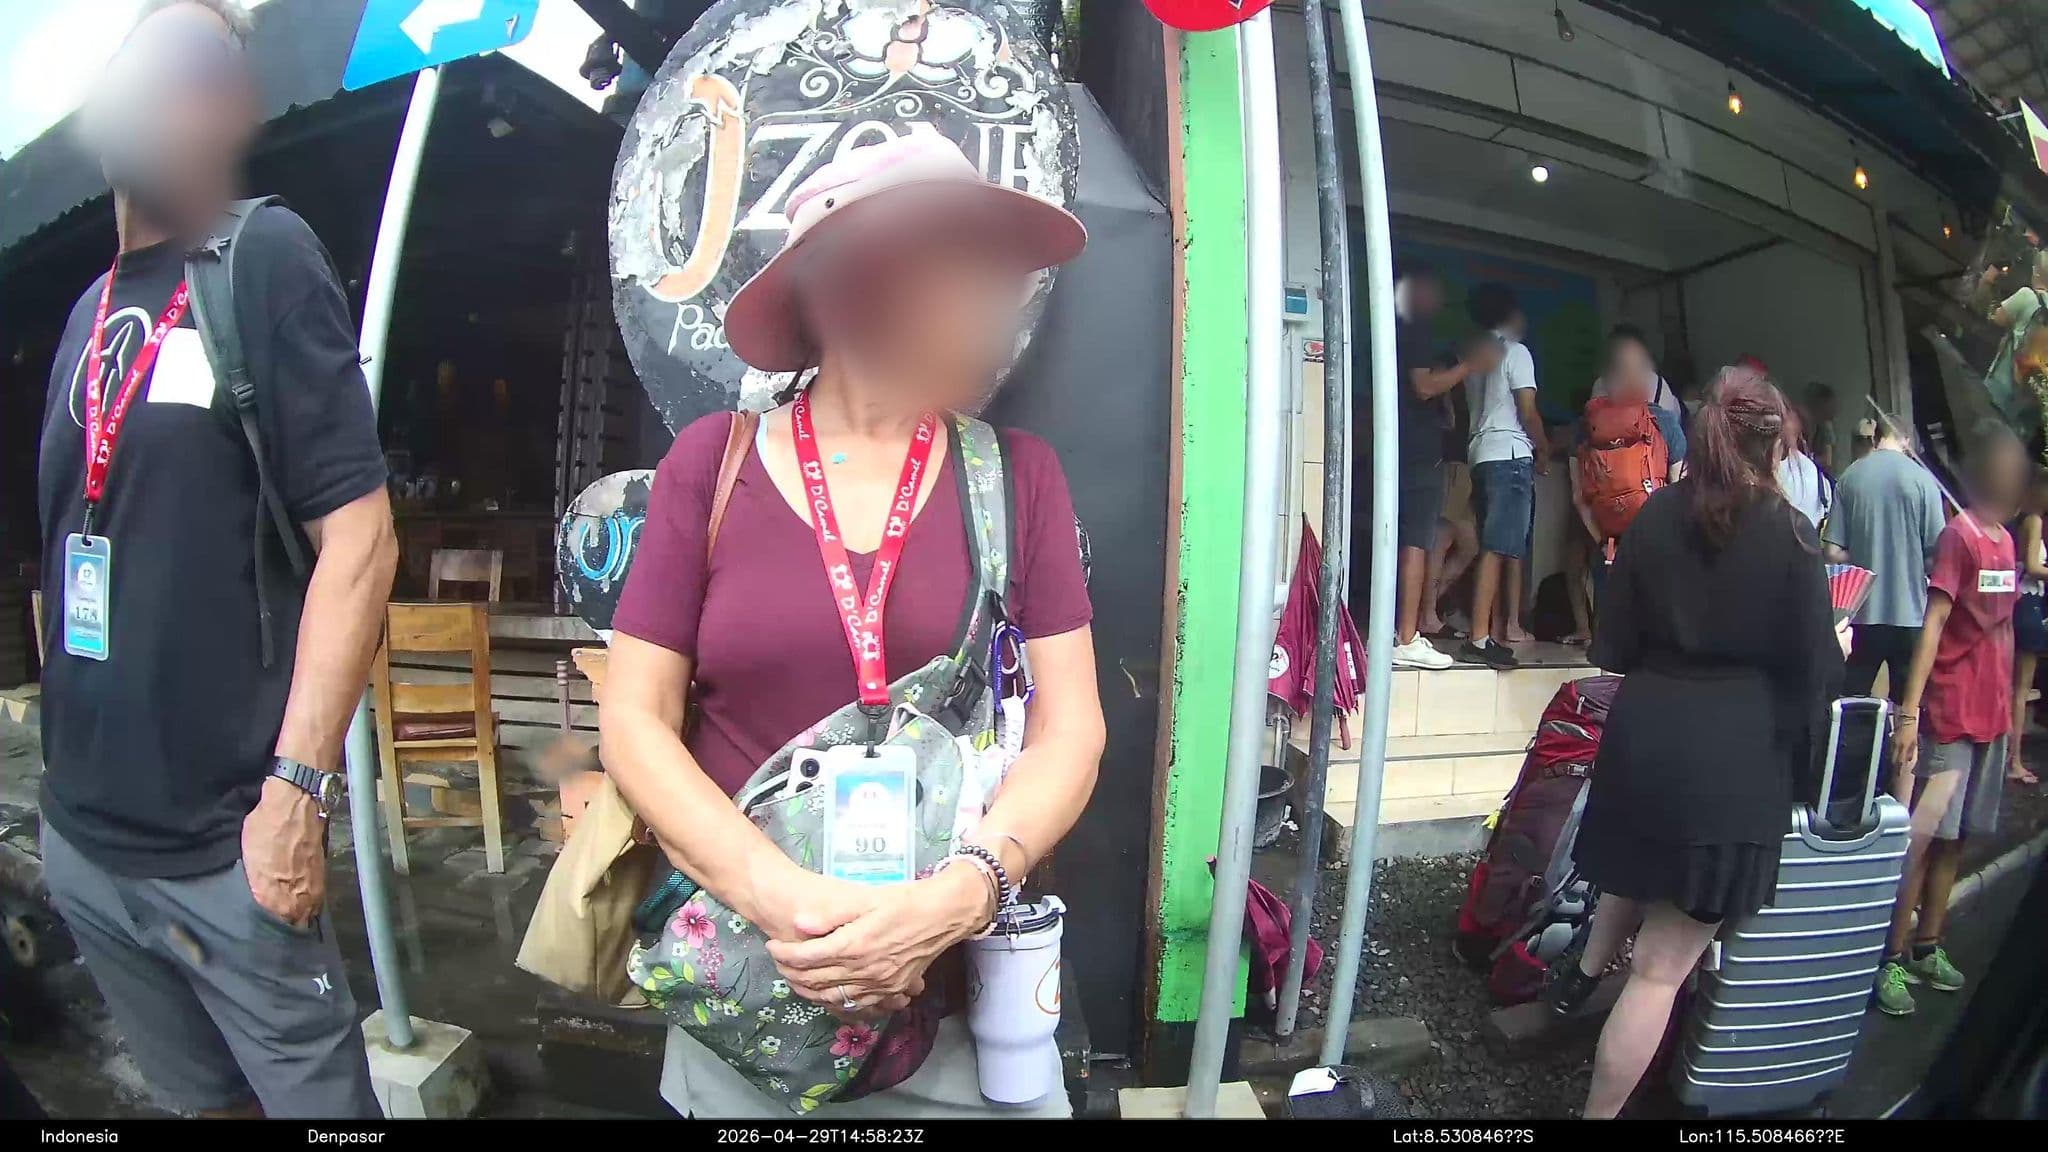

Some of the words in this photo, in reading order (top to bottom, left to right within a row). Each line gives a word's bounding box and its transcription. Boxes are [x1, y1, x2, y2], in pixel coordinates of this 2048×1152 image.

[896, 458, 921, 512] D'Camel
[811, 484, 838, 543] D'Camel
[864, 560, 892, 624] D'Camel
[855, 836, 887, 854] 90
